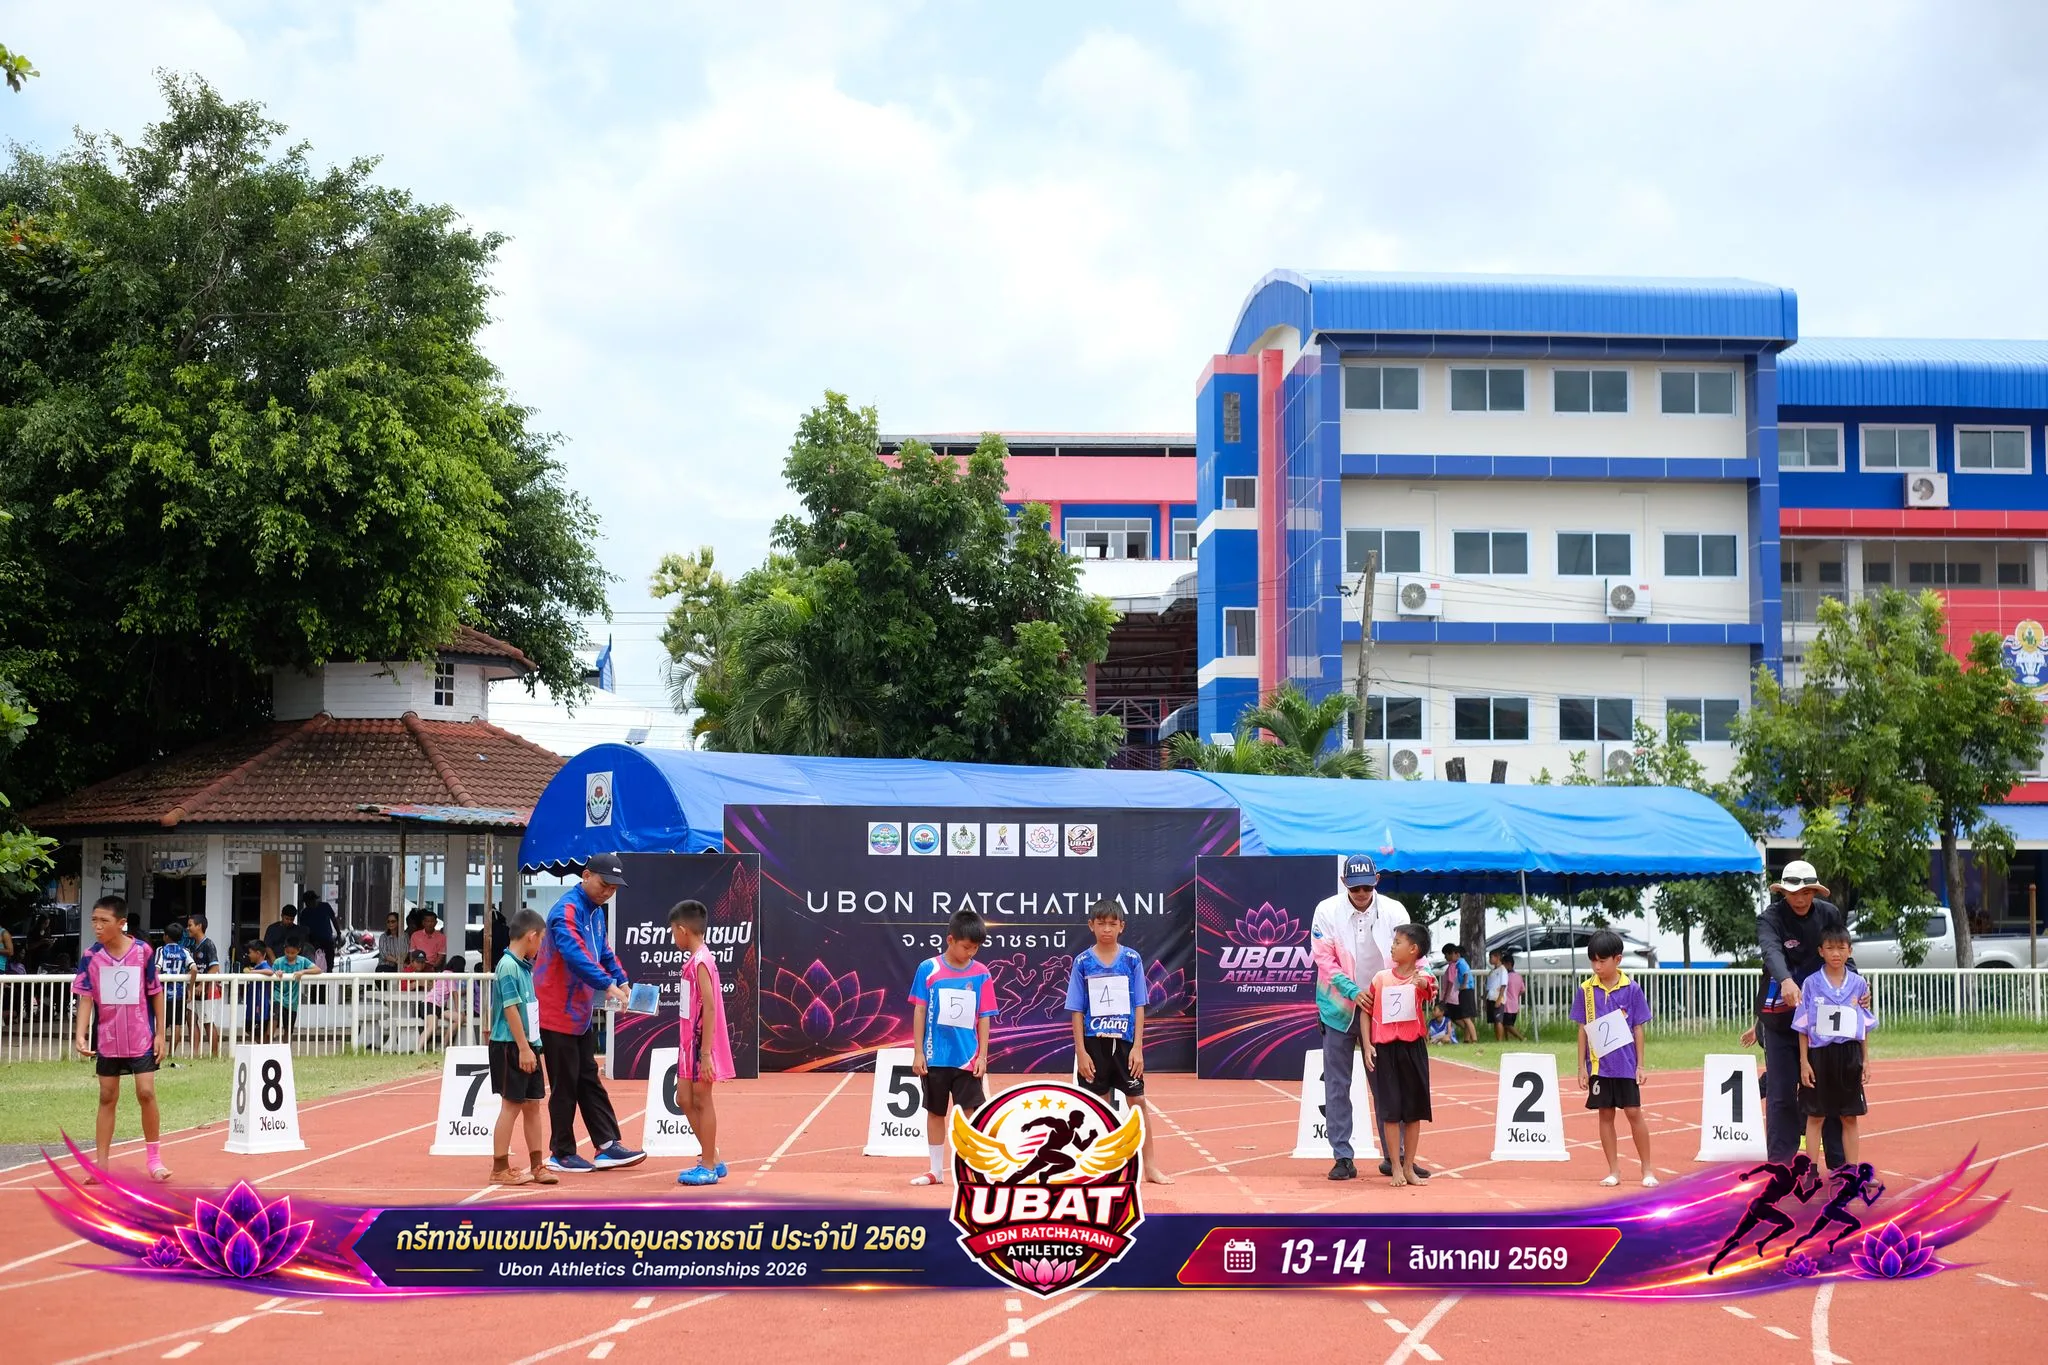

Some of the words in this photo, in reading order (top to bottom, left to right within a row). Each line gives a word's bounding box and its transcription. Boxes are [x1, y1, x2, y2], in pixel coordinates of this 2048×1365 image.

[1350, 863, 1370, 874] THAI
[806, 890, 914, 914] UBON
[932, 891, 1165, 915] RATCHATHANI
[902, 929, 1067, 953] จ.อุราชธานี
[1218, 946, 1315, 969] UBON
[114, 970, 129, 1000] 8
[1220, 970, 1315, 983] ATHLETICS
[950, 996, 965, 1020] 5
[1099, 984, 1114, 1008] 4
[1389, 993, 1402, 1017] 3
[1090, 1017, 1129, 1032] Chang
[1828, 1011, 1841, 1031] 1
[1598, 1021, 1619, 1048] 2
[236, 1062, 248, 1115] 8
[261, 1059, 284, 1112] 8
[456, 1063, 490, 1117] 7
[886, 1065, 921, 1118] 5
[1512, 1071, 1545, 1123] 2
[1592, 1080, 1601, 1096] 6
[1720, 1070, 1743, 1123] 1
[259, 1116, 286, 1132] Nelco
[449, 1120, 489, 1136] Nelco
[881, 1121, 921, 1137] Nelco
[1507, 1127, 1547, 1143] Nelco
[1712, 1125, 1749, 1141] Nelco
